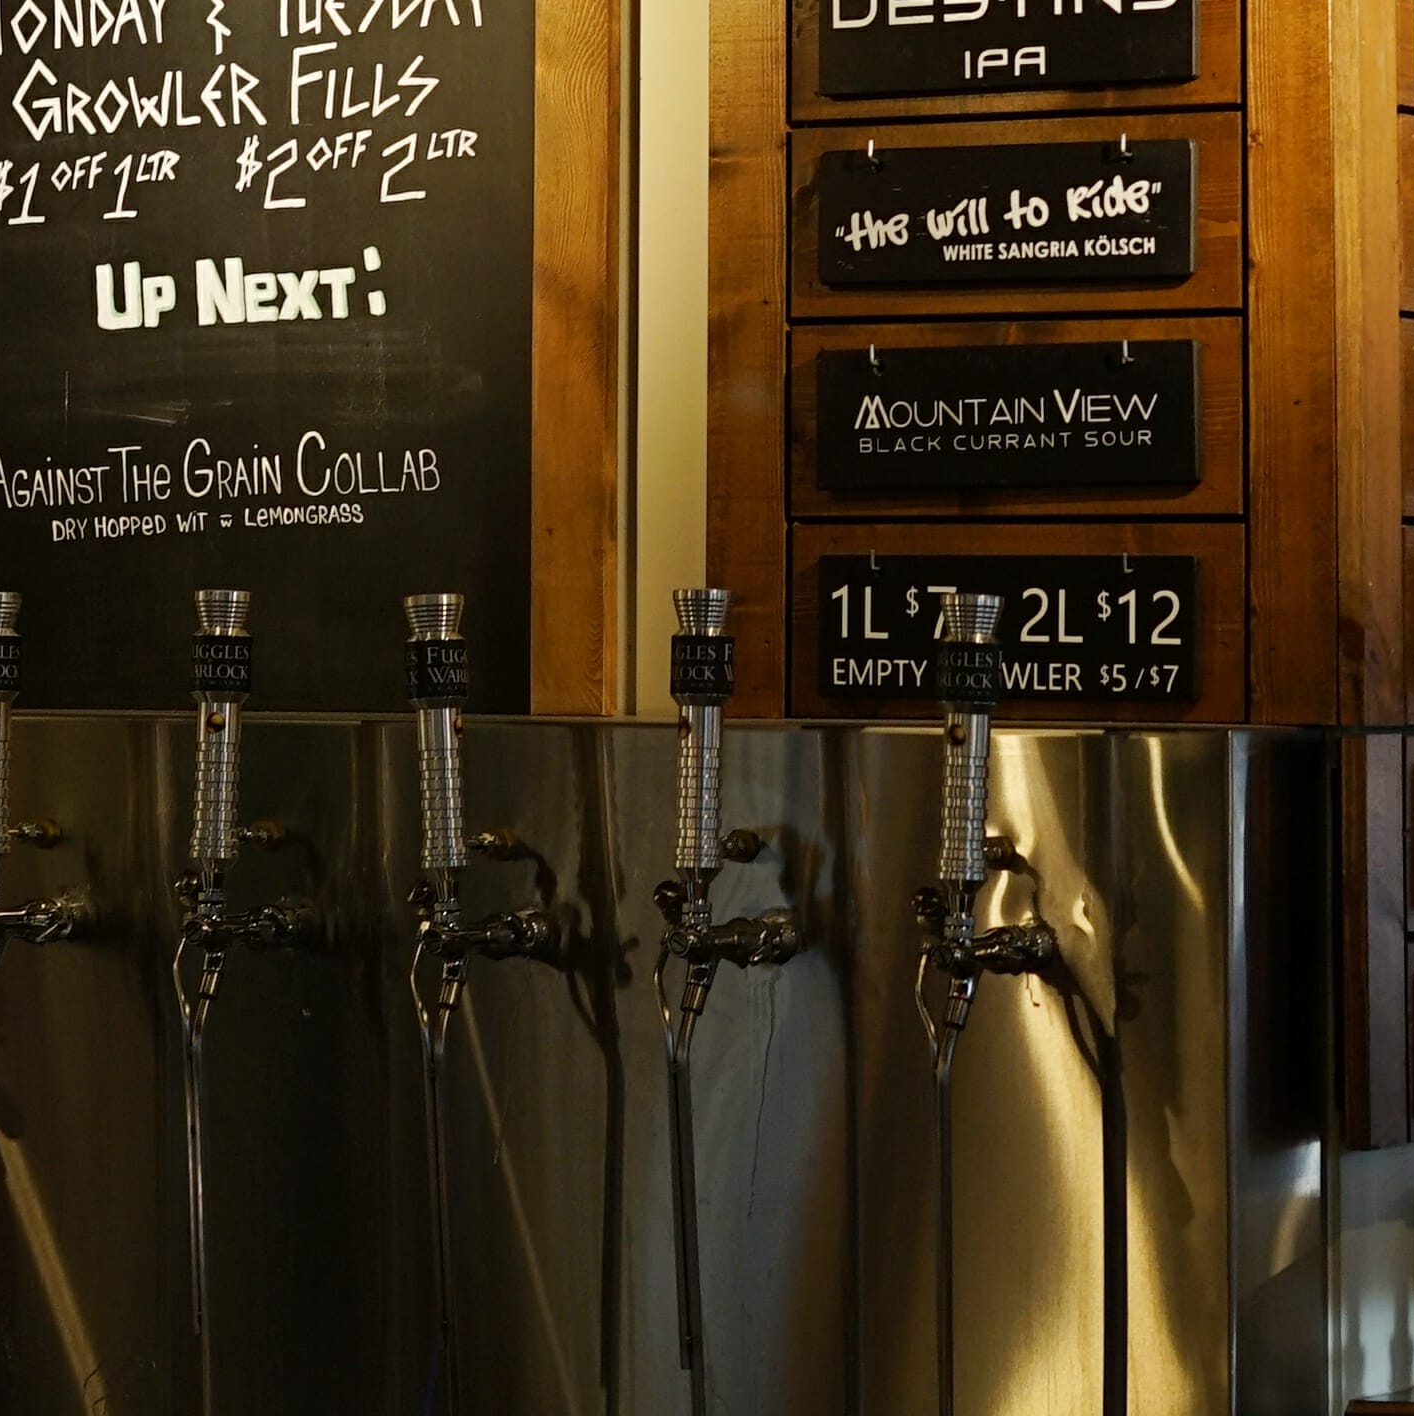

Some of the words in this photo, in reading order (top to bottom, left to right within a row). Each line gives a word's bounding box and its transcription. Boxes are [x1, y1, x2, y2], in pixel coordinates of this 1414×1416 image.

[964, 46, 1046, 79] IPA
[12, 59, 267, 141] GROWLER
[290, 42, 439, 125] FILLS
[51, 152, 108, 191] OFF
[236, 135, 306, 210] $2
[306, 130, 372, 172] OFF
[1003, 189, 1049, 230] to
[943, 242, 993, 262] WHITE
[998, 239, 1079, 260] SANGRIA
[1084, 235, 1155, 257] KÖLSCH
[853, 394, 1045, 430] MOUNTAIN
[1053, 388, 1158, 424] VIEW
[859, 436, 942, 454] BLACK
[954, 432, 1072, 451] CURRANT
[1084, 429, 1153, 447] SOUR
[296, 430, 440, 497] COLLAB
[52, 519, 87, 543] DRY
[831, 584, 889, 641] 1L
[1019, 587, 1084, 644] 2L
[1096, 588, 1182, 645] $12
[832, 658, 927, 686] EMPTY
[1001, 661, 1083, 692] WLER
[1099, 664, 1126, 693] $5
[1149, 665, 1179, 693] $7
